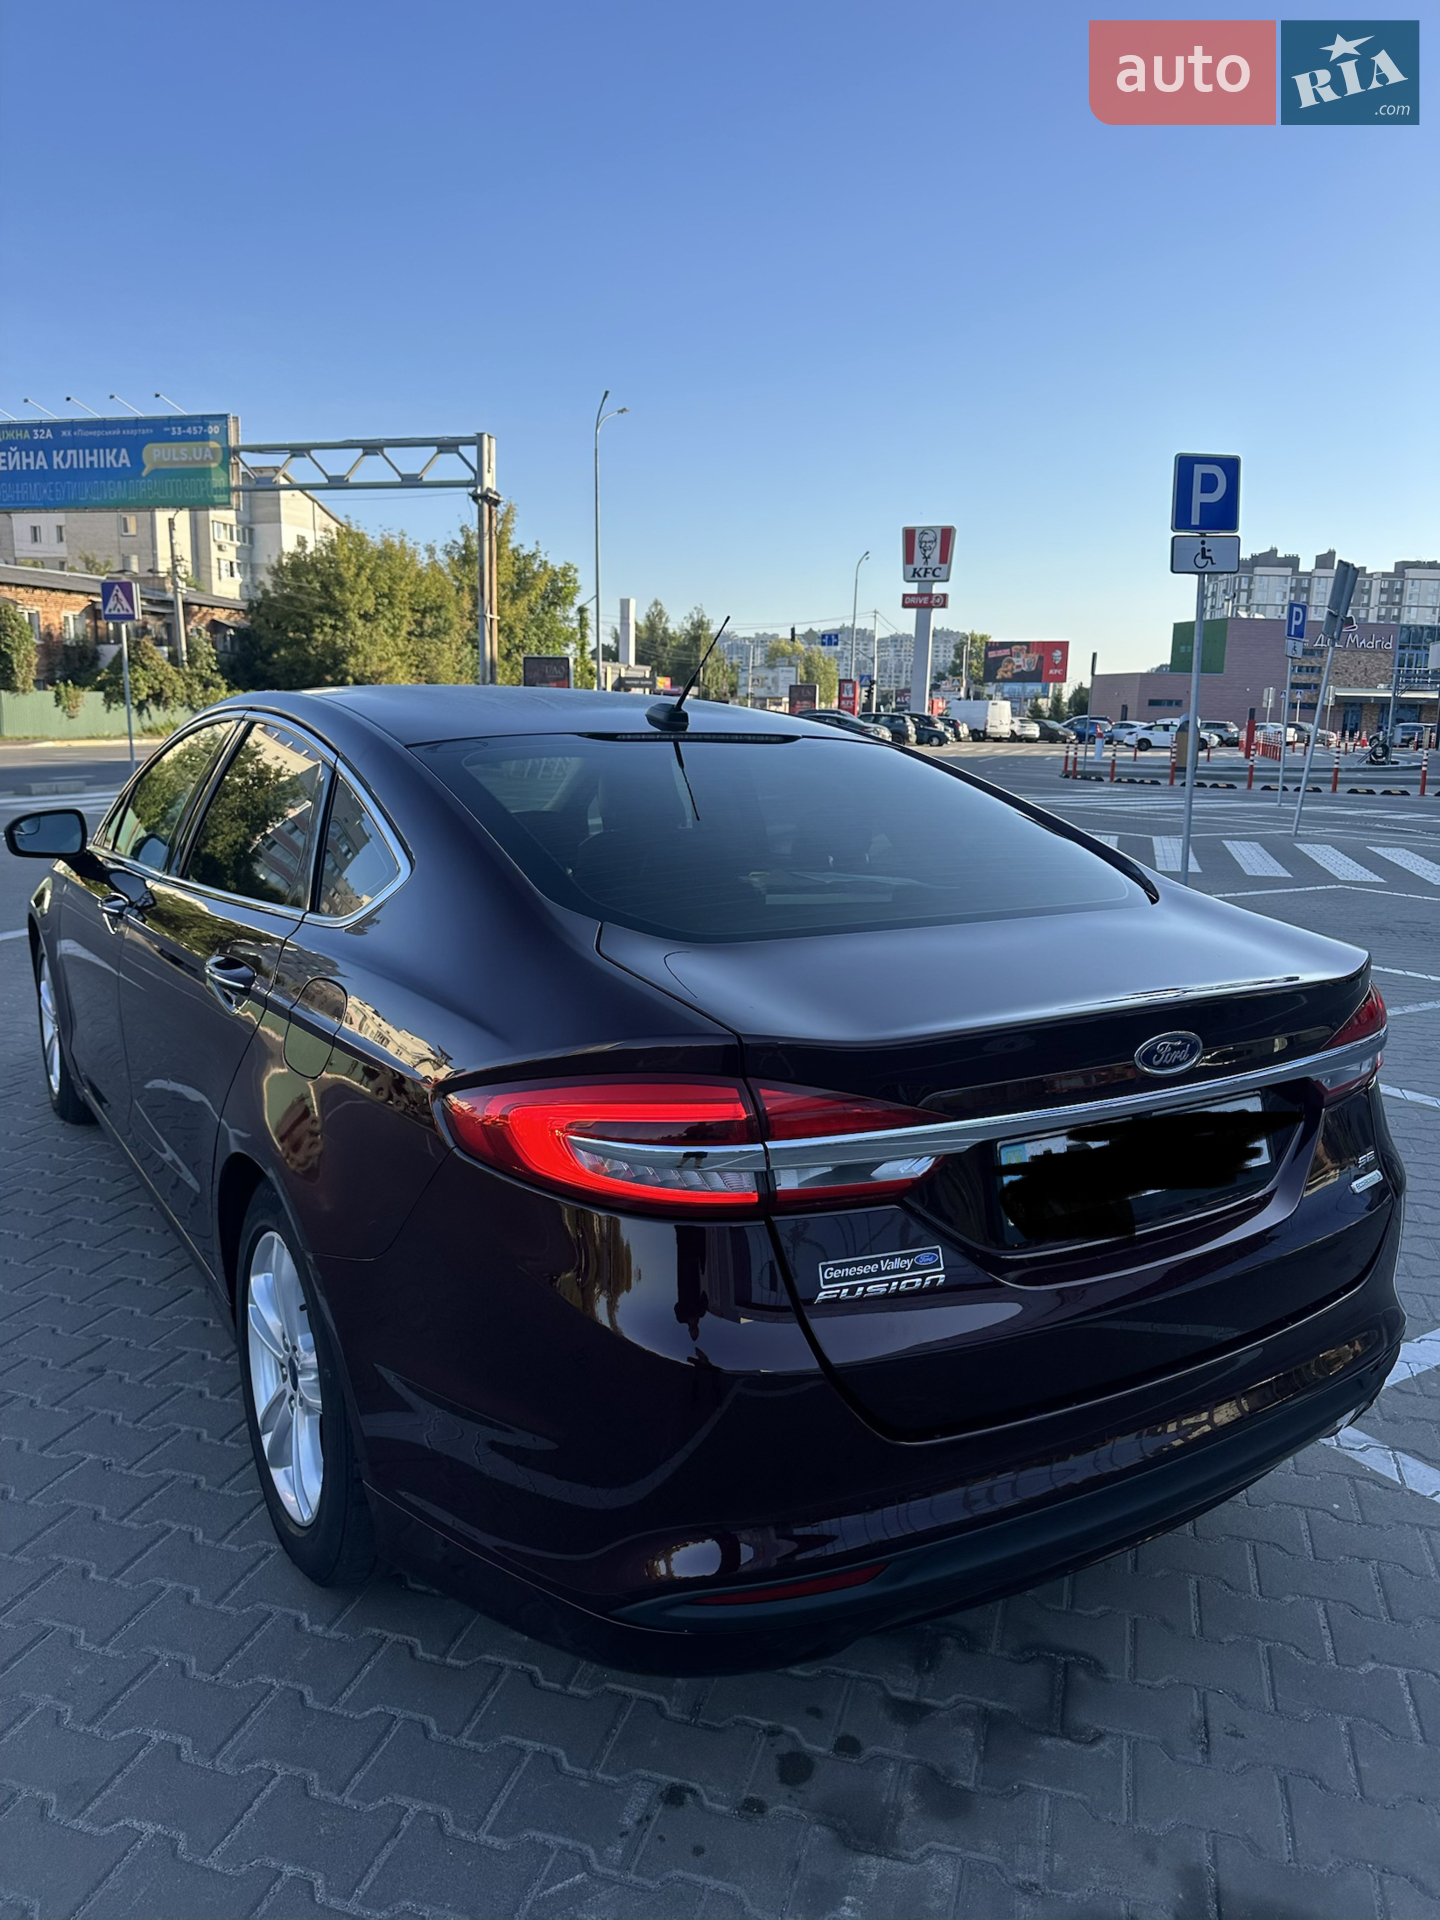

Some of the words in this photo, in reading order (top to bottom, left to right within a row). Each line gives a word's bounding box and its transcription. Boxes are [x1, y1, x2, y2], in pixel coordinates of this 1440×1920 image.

[53, 448, 131, 469] КЛІНІКА
[152, 447, 213, 462] PULS.UA
[1191, 464, 1227, 526] P
[911, 567, 942, 578] KFC
[904, 596, 929, 604] DRIVE
[1291, 606, 1303, 636] P
[1346, 633, 1393, 650] Madrid
[1151, 1040, 1190, 1066] Ford
[823, 1262, 879, 1280] Genesee
[880, 1257, 914, 1272] Valley
[814, 1274, 946, 1305] FUSION
